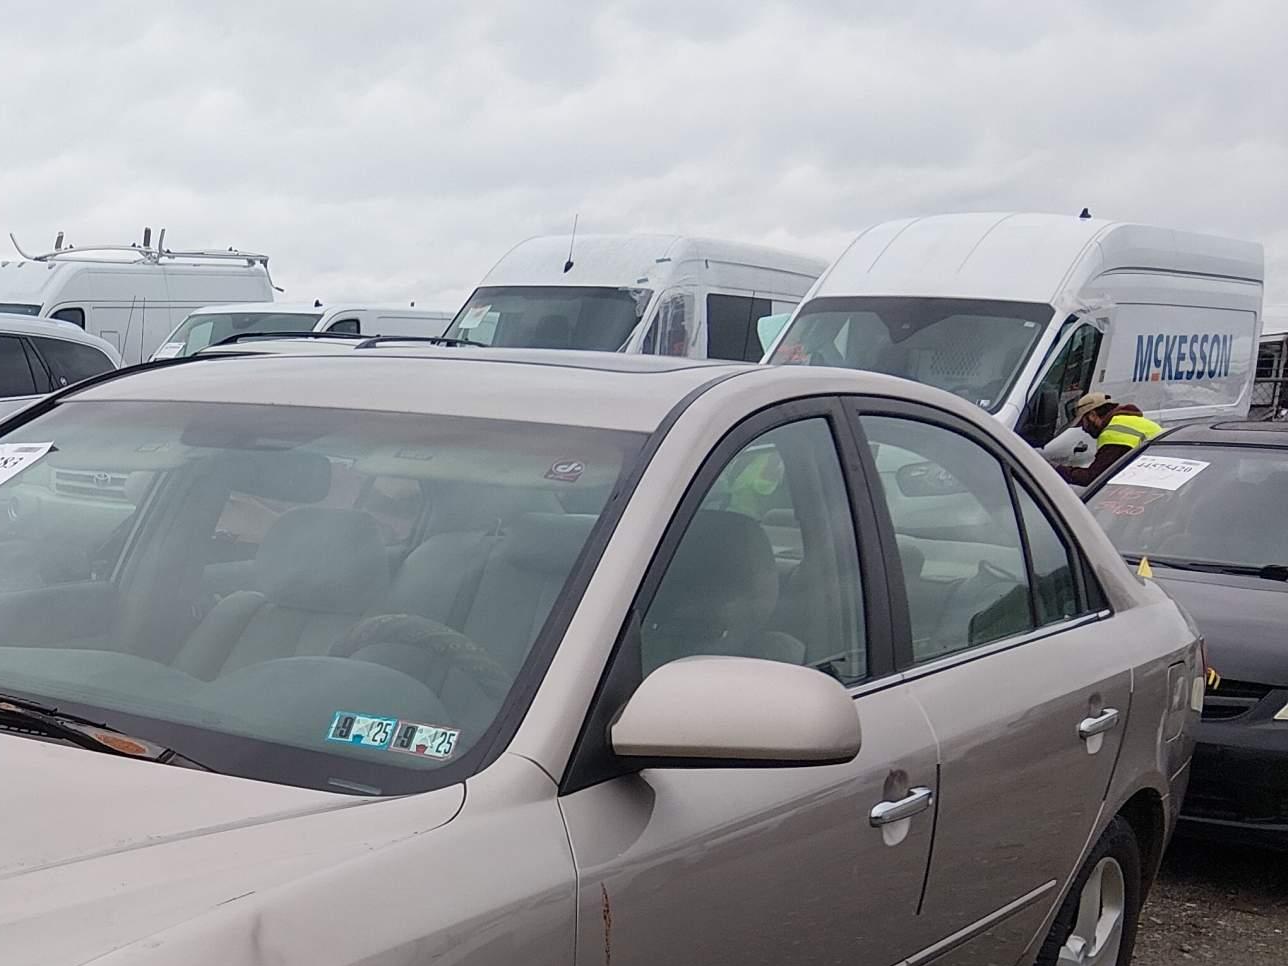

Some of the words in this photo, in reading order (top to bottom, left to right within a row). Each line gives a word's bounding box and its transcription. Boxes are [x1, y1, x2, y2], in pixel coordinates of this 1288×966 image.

[338, 716, 354, 738] 9
[372, 721, 392, 743] 25
[399, 725, 416, 748] 9
[435, 731, 456, 754] 25
